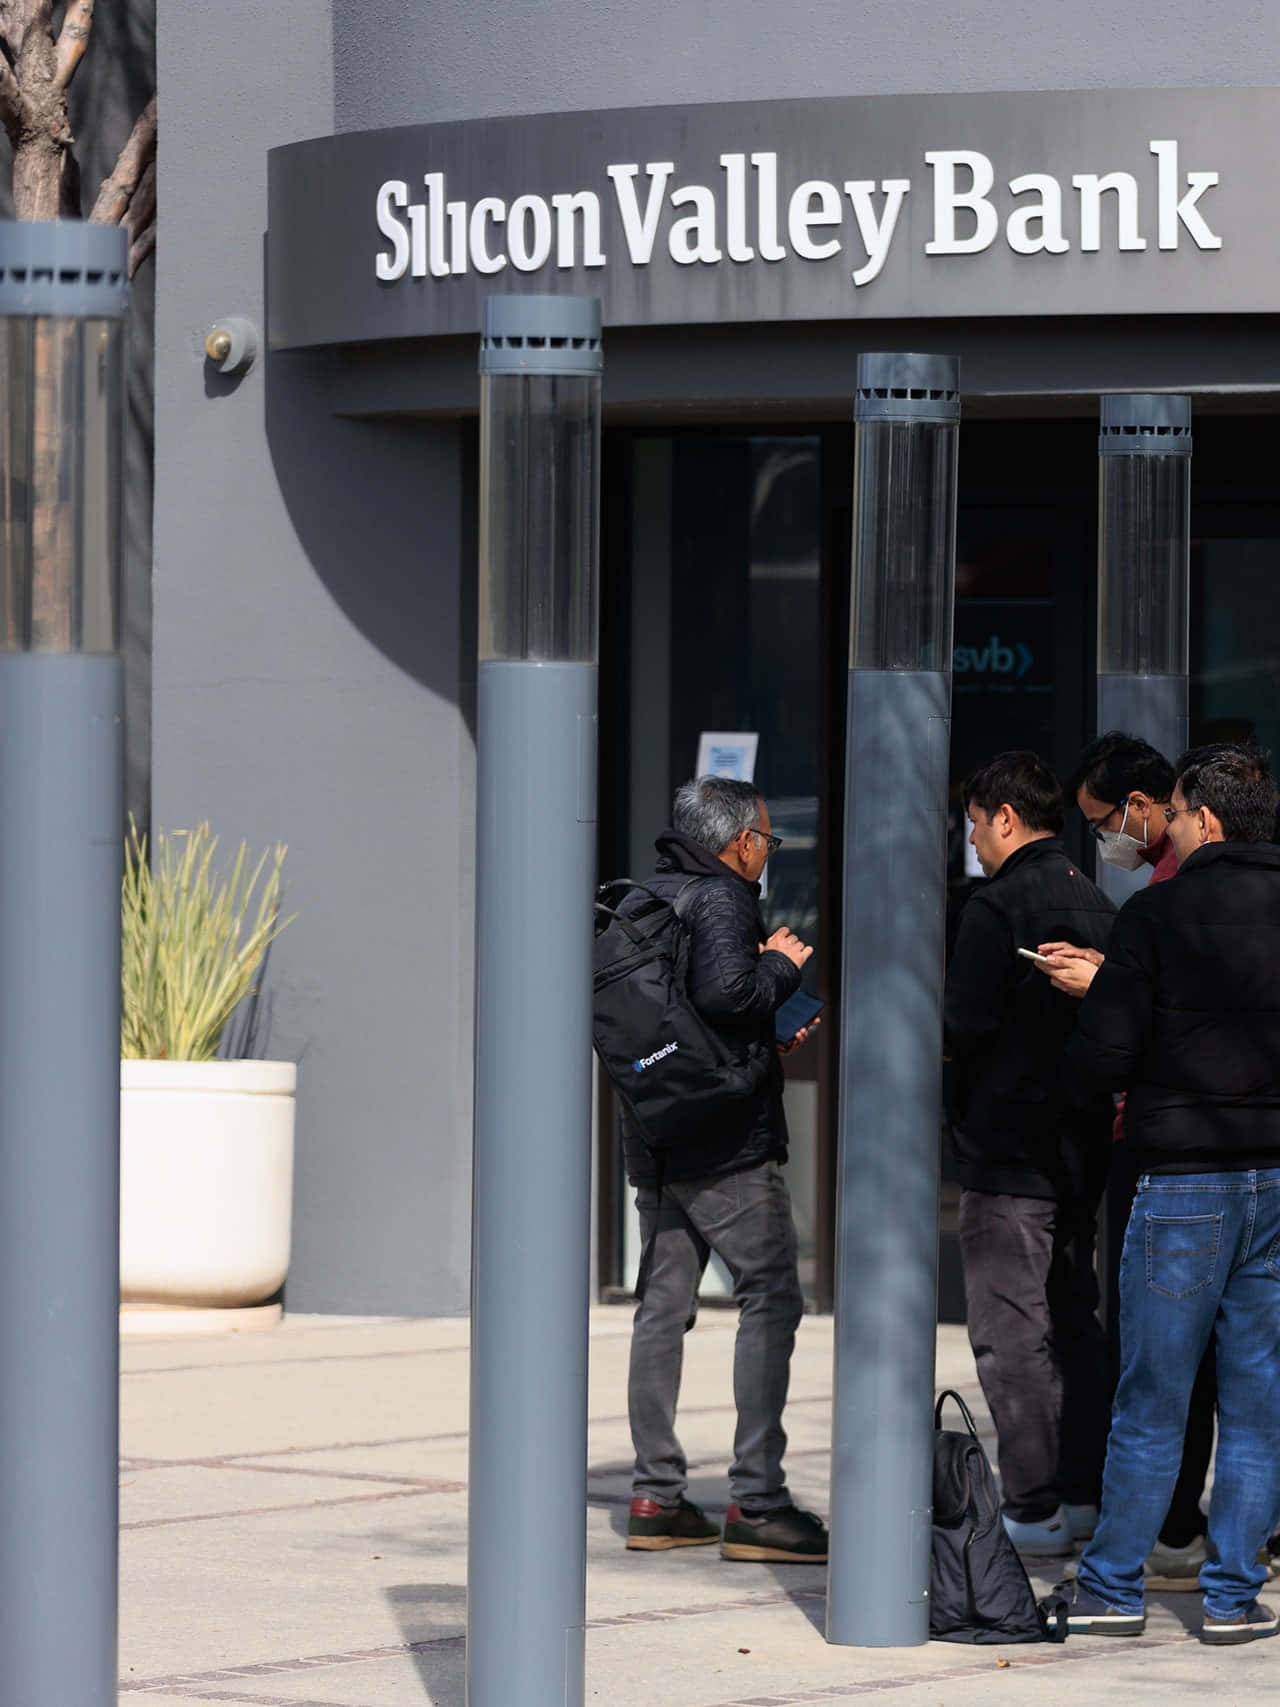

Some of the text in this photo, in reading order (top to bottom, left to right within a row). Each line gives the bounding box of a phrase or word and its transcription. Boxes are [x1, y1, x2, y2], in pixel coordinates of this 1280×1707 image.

[376, 140, 1222, 286] Silicon Valley Bank
[952, 636, 1015, 673] svb
[639, 1041, 678, 1069] Fortanix
